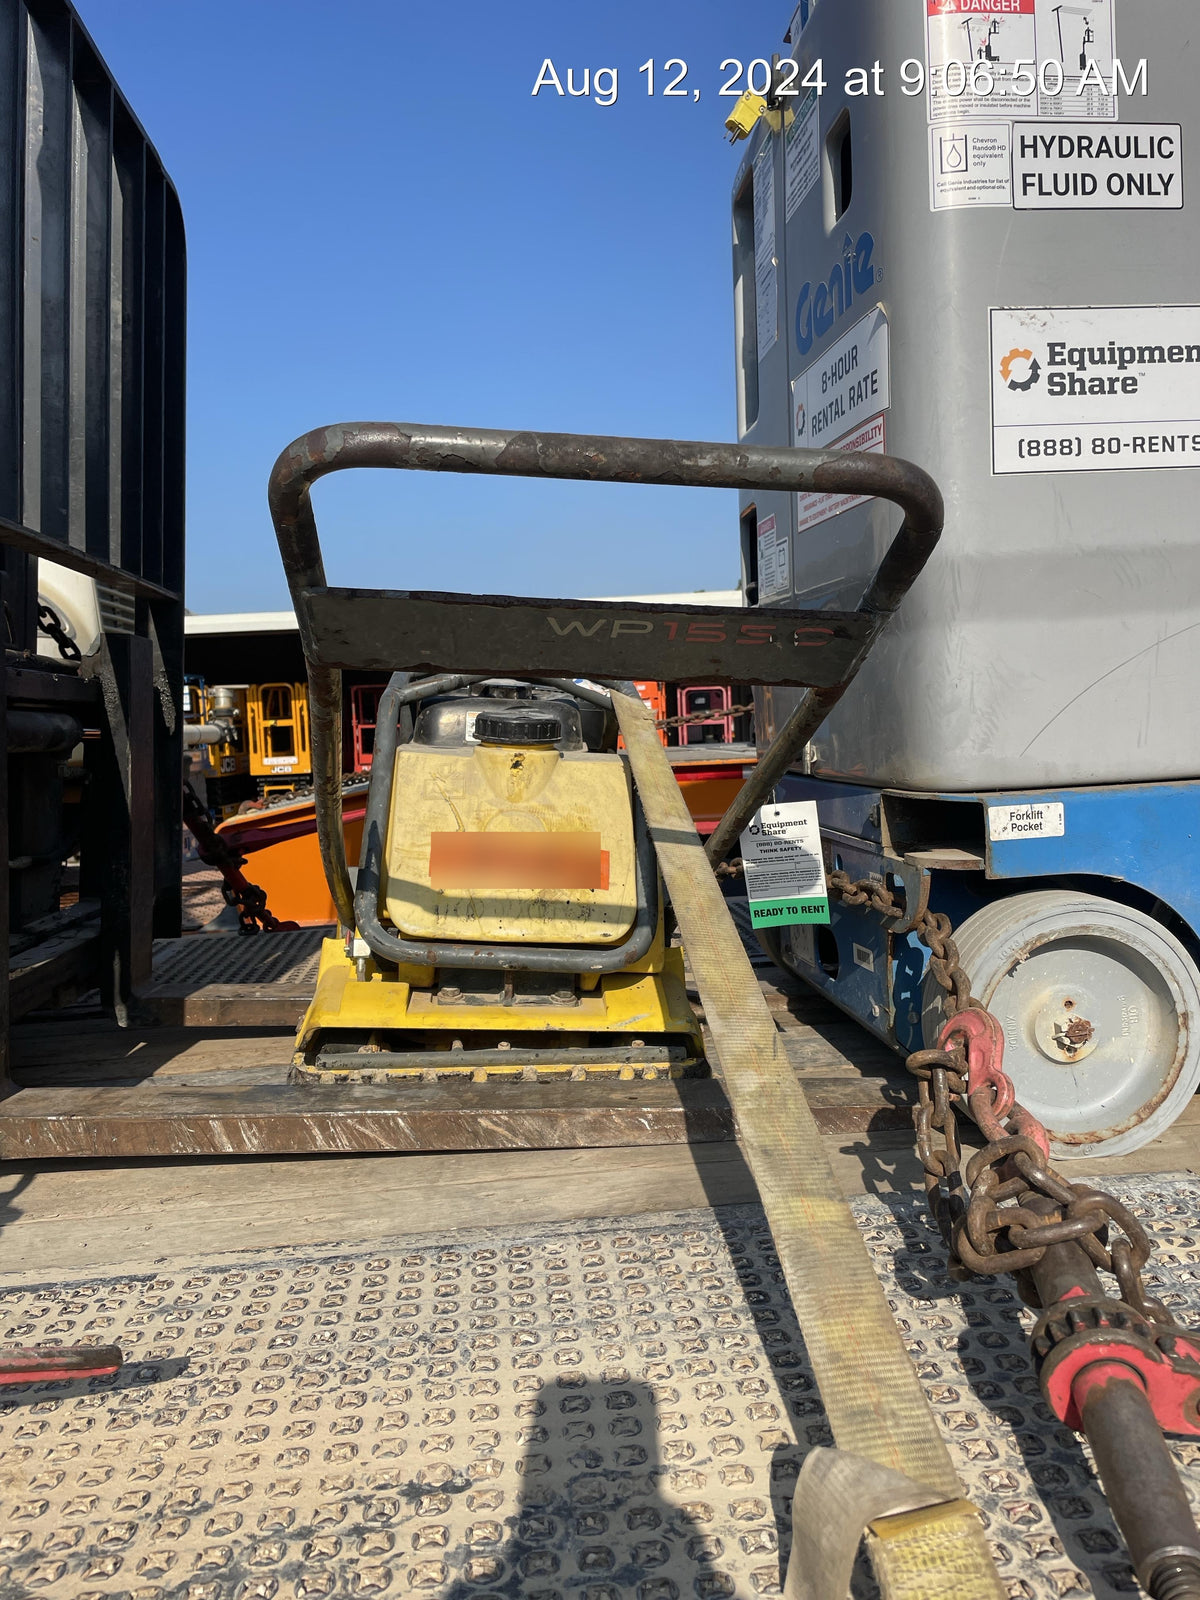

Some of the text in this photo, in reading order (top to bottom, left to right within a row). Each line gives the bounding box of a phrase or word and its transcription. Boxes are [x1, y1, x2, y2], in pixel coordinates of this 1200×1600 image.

[961, 0, 1020, 11] DANGER
[1020, 135, 1174, 159] HYDRAULIC
[1022, 172, 1175, 196] FLUID ONLY
[822, 344, 858, 394] 8-HOUR
[811, 368, 878, 438] RENTAL RATE
[1018, 437, 1082, 458] (888)
[221, 756, 236, 773] JCB
[271, 766, 292, 774] JCB
[1010, 810, 1043, 821] Forklift
[760, 819, 808, 829] Equipment
[1011, 822, 1042, 832] Pocket
[754, 905, 825, 918] READY TO RENT
